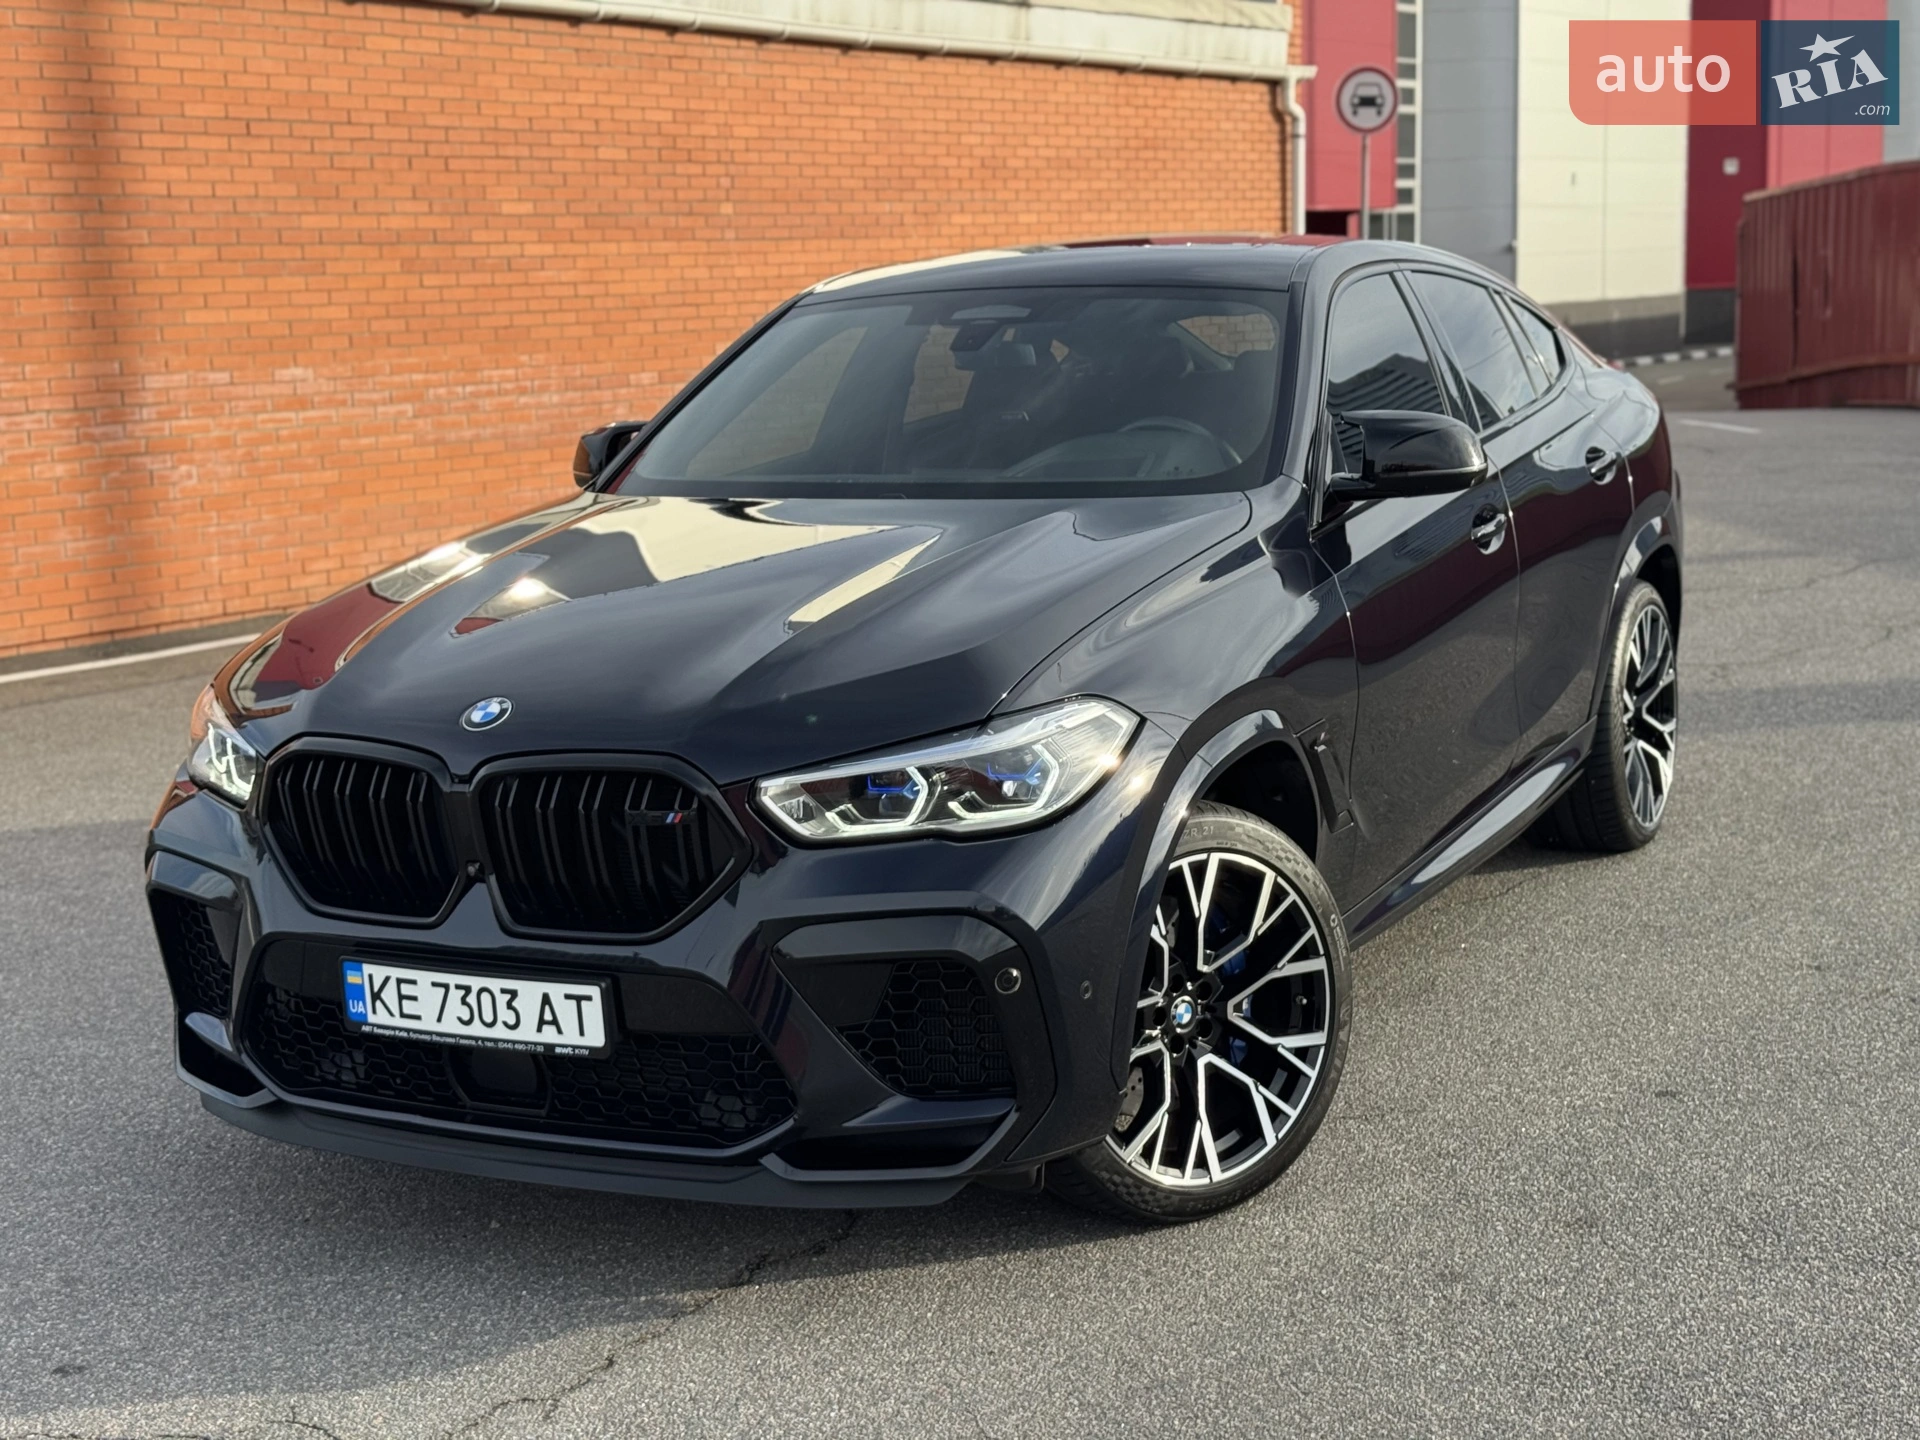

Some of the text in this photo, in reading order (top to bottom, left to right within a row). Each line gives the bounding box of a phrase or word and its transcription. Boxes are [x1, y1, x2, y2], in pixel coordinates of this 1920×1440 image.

[1203, 826, 1214, 836] 21
[349, 999, 366, 1014] UA
[368, 973, 593, 1037] KE 7303 AT
